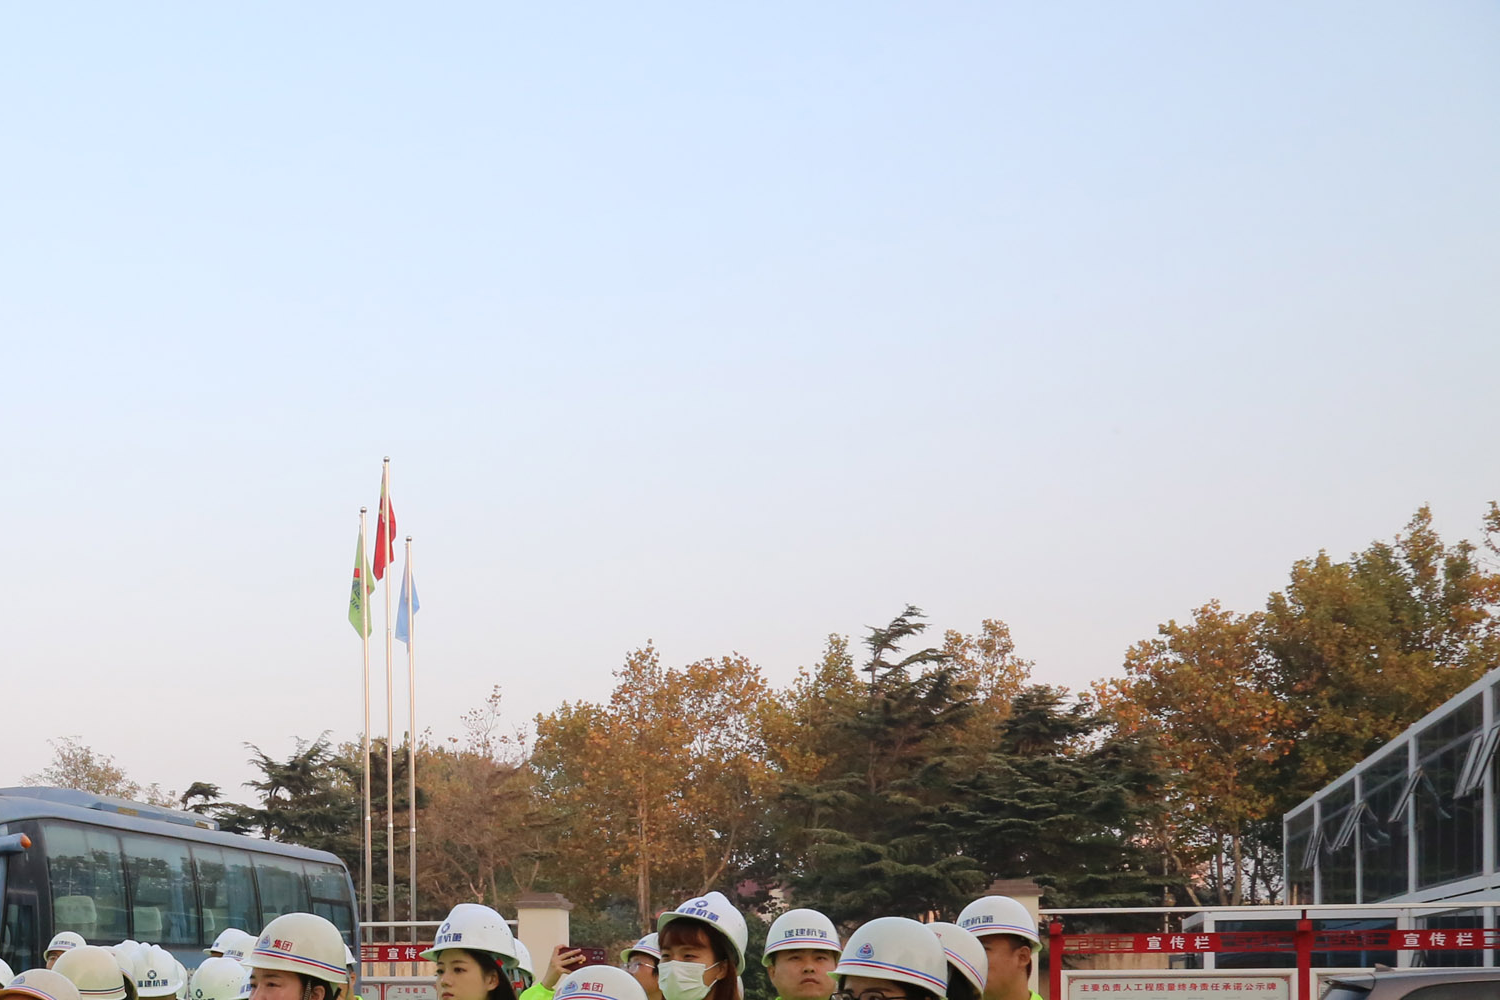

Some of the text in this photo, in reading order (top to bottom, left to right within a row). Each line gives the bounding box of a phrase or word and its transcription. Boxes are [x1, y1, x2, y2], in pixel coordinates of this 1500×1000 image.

[272, 939, 293, 952] 集团
[1147, 936, 1210, 950] 宣传栏
[1404, 932, 1474, 947] 宣传栏
[387, 945, 417, 959] 宣传
[581, 982, 604, 993] 集团
[1080, 982, 1277, 992] 主要负责人工程质量终身责任承诺公示牌
